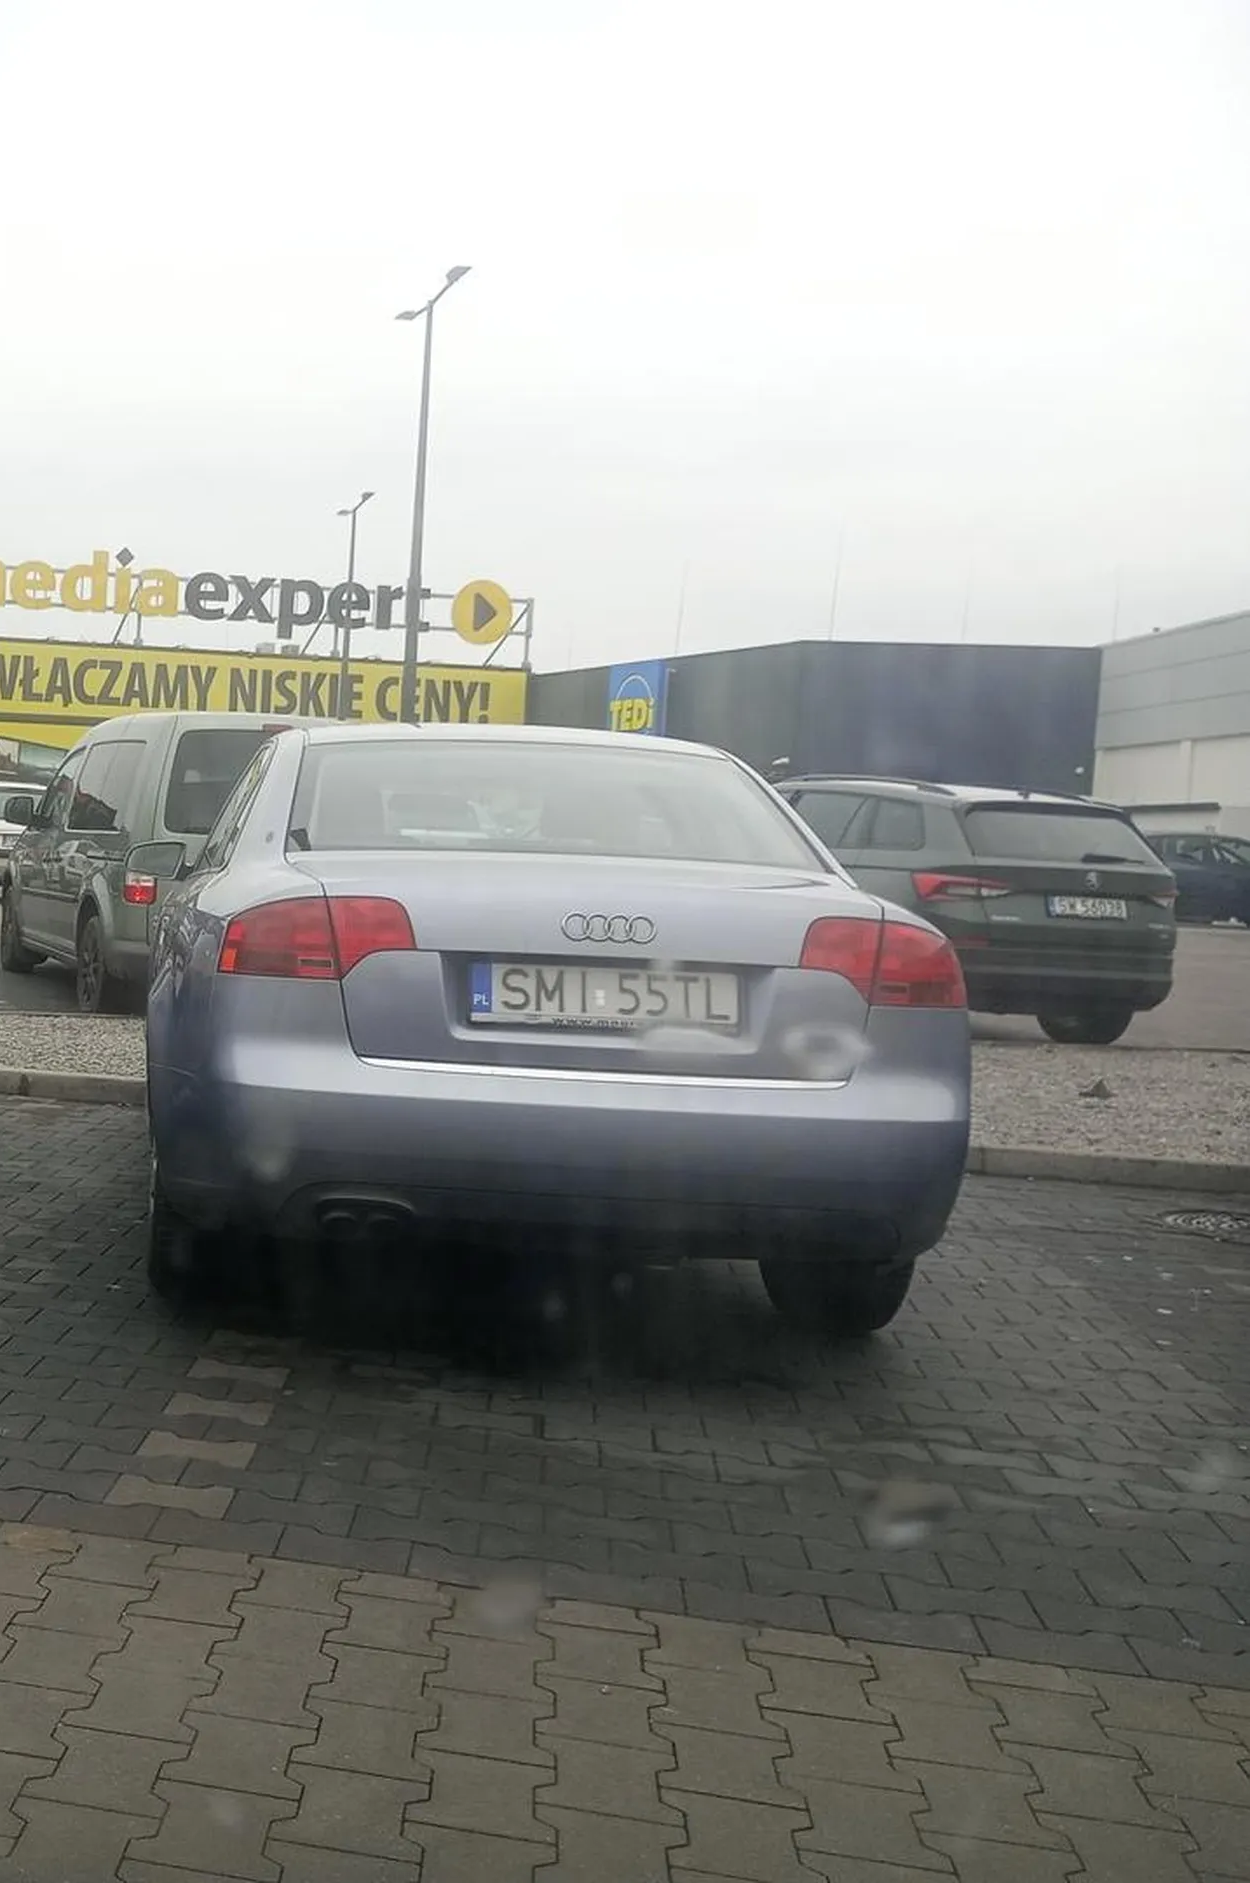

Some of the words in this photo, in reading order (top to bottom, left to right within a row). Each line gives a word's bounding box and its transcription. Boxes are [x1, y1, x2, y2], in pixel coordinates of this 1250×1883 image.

[228, 667, 364, 719] NISKIE
[473, 993, 489, 1005] PL
[500, 967, 588, 1013] SMI
[617, 972, 730, 1021] 55TL
